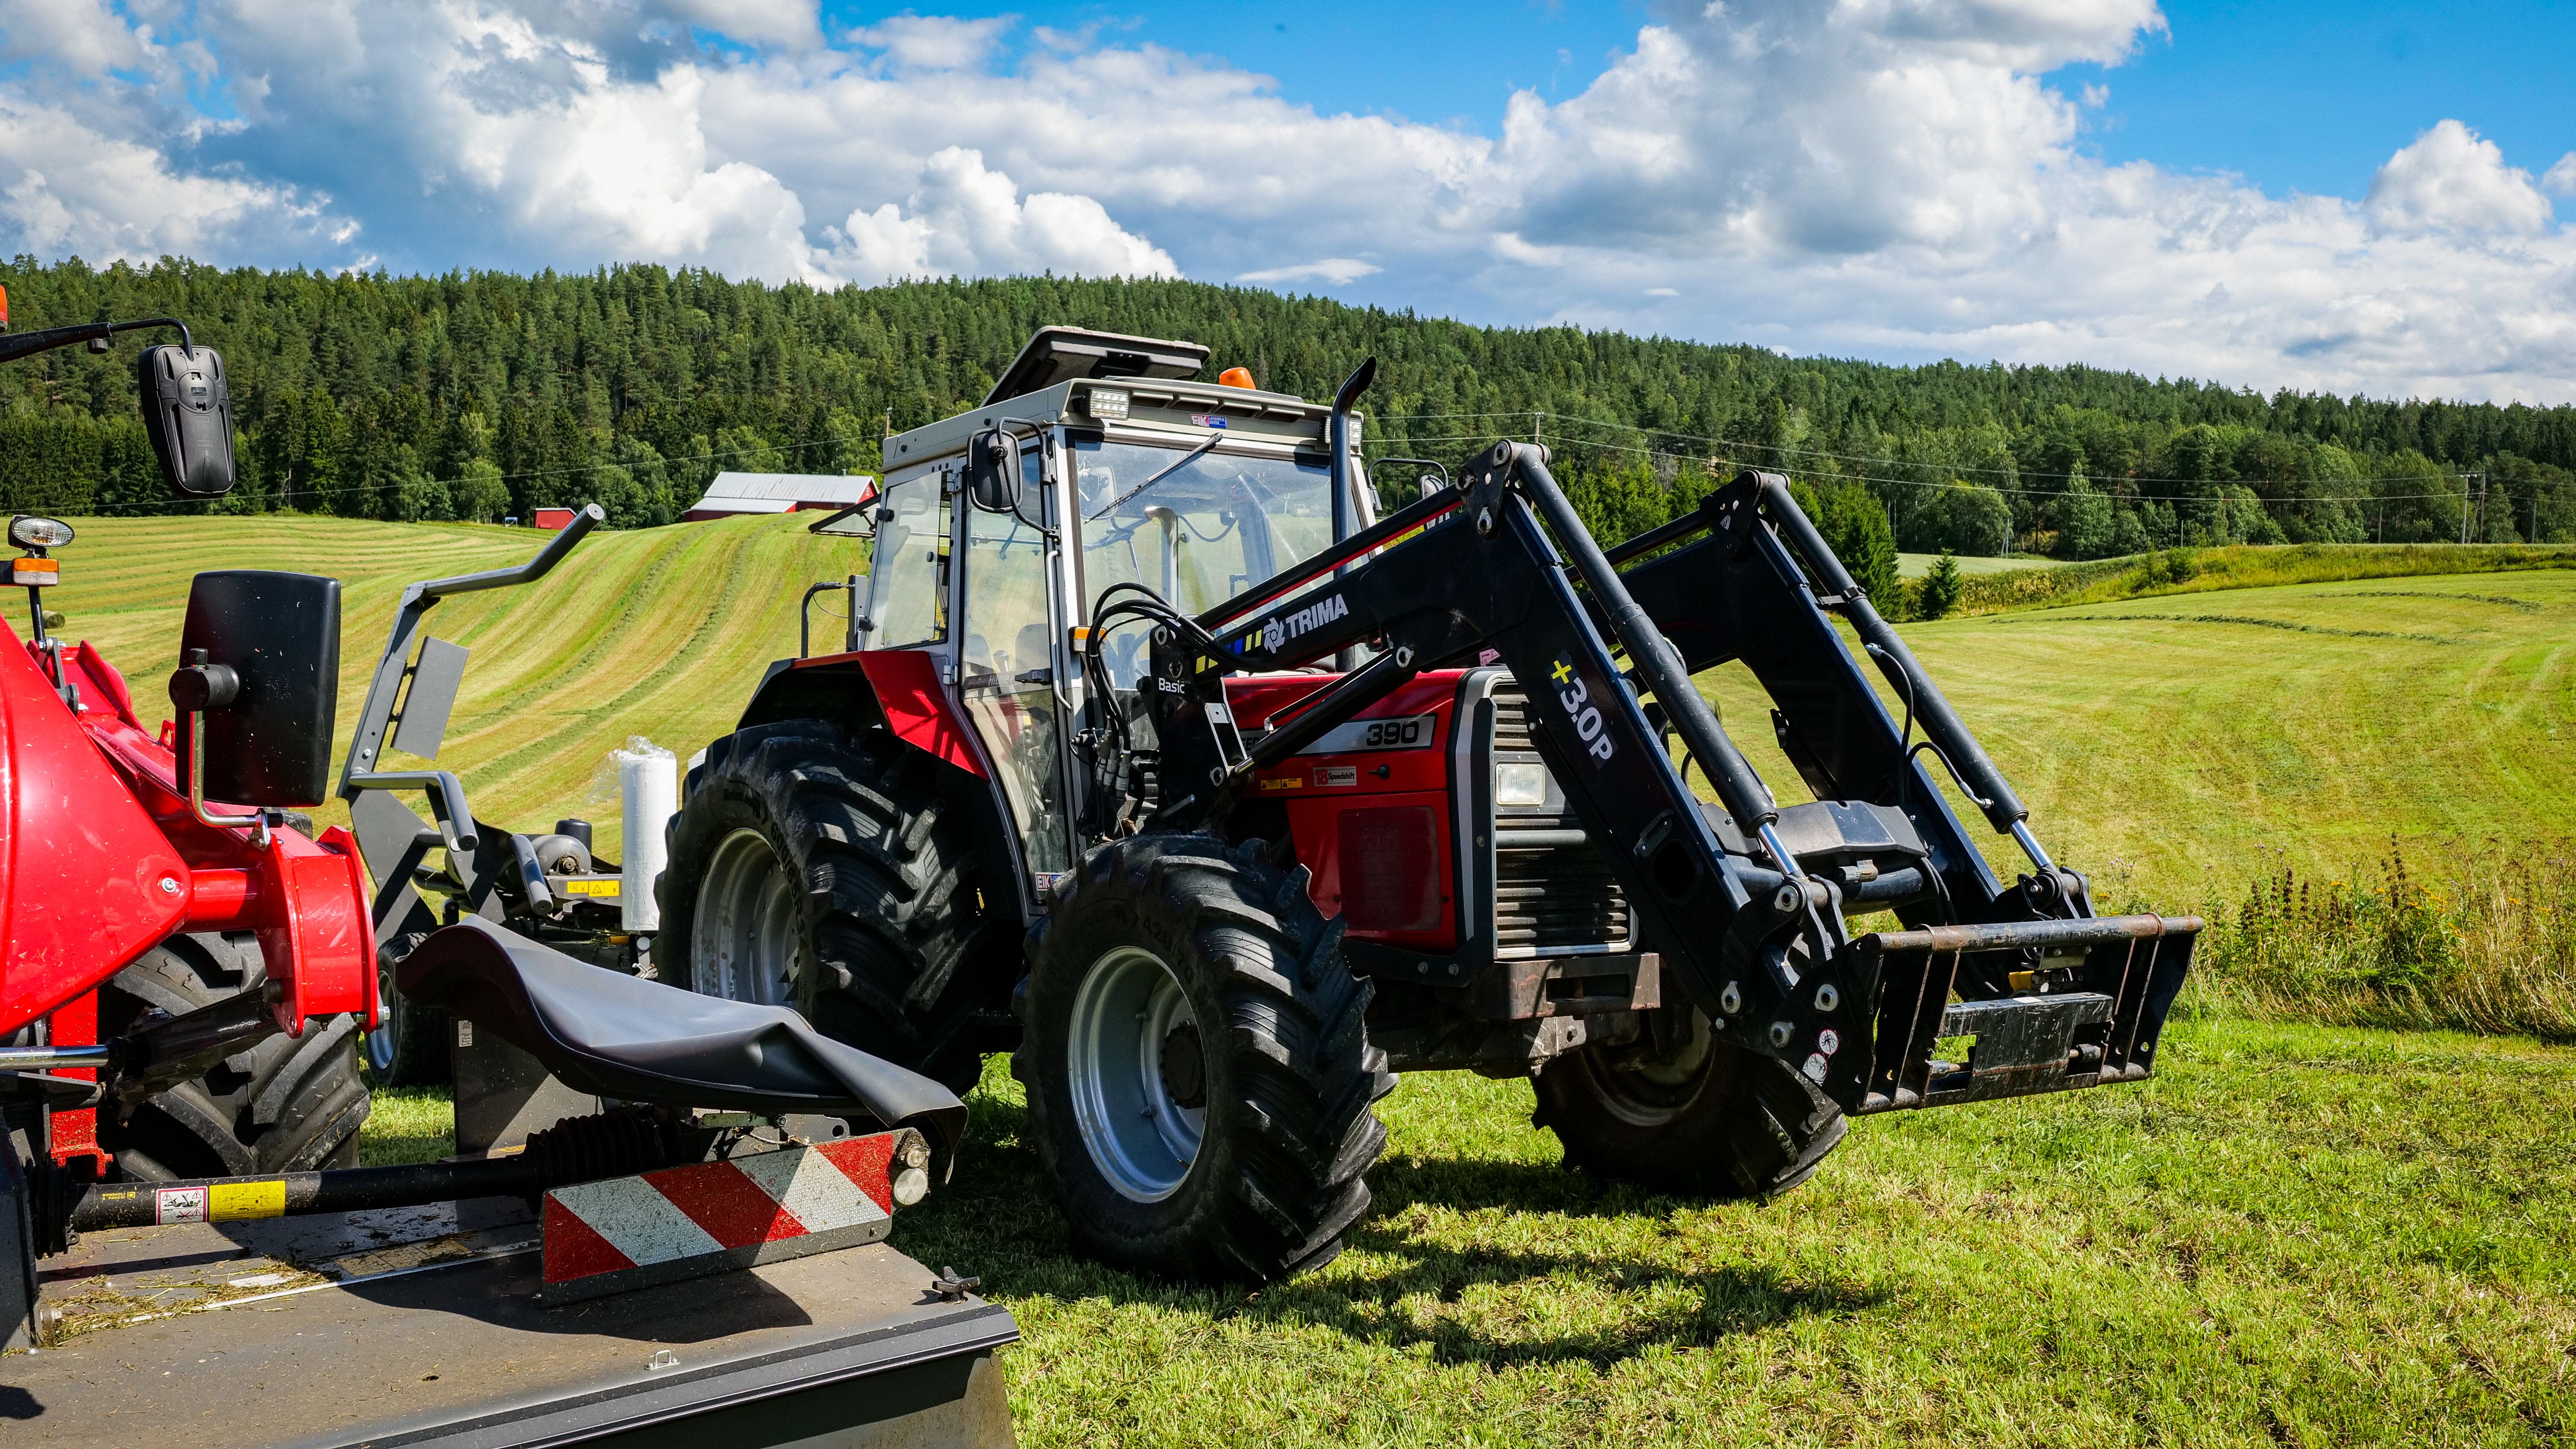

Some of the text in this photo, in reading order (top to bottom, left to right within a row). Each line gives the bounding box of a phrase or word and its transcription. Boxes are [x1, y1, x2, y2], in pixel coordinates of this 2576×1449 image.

[1191, 415, 1208, 426] EIK
[1285, 593, 1349, 638] TRIMA
[1159, 677, 1185, 694] Basic
[1551, 660, 1612, 760] +3.0P
[1366, 721, 1419, 746] 390
[1328, 772, 1355, 781] Speedshift
[1037, 875, 1050, 888] EIK
